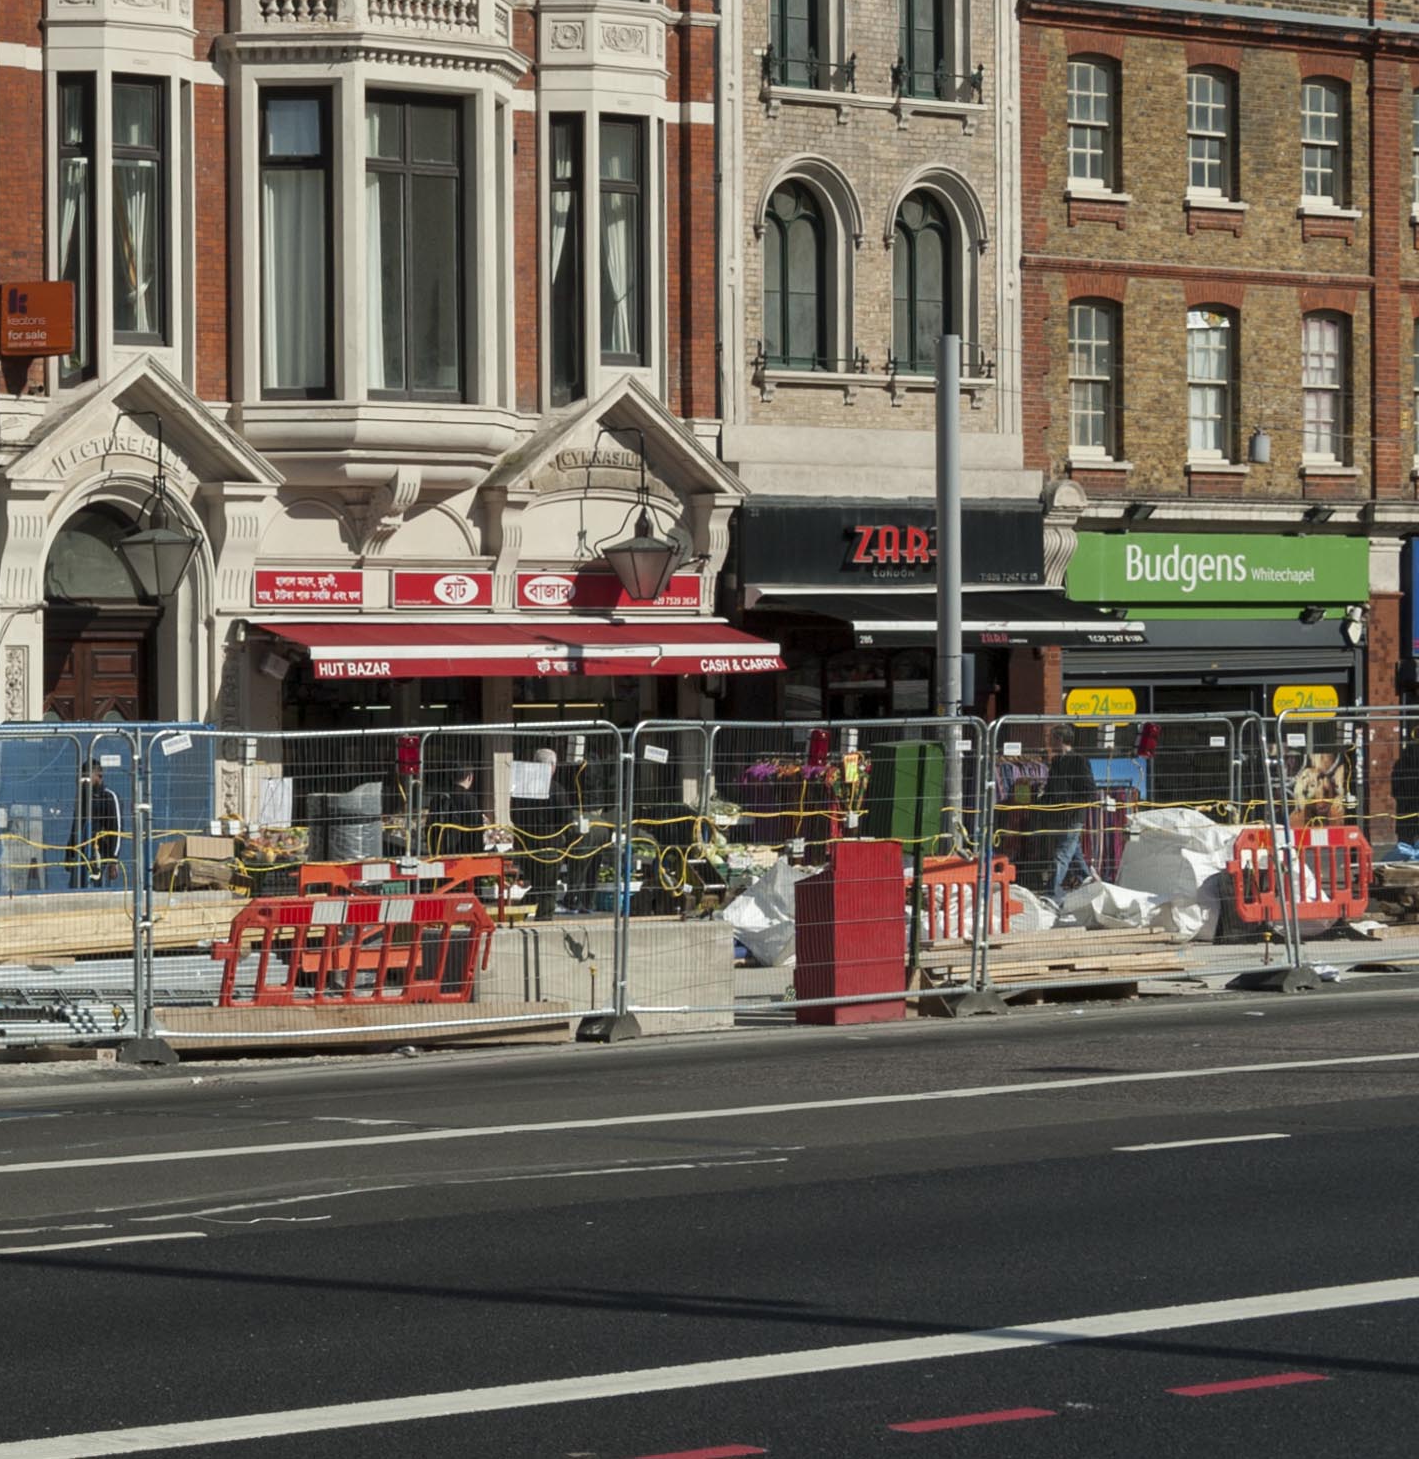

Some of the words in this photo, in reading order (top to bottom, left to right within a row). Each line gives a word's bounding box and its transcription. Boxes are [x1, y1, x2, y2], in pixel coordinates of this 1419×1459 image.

[8, 330, 23, 340] for
[25, 330, 47, 340] sale
[56, 435, 139, 472] LECTURE
[852, 525, 937, 564] ZAR
[1125, 544, 1247, 592] Budgens
[1250, 567, 1316, 585] Whitechapel
[443, 576, 468, 601] হাট
[318, 662, 345, 676] HUT
[347, 662, 391, 676] BAZAR
[700, 659, 731, 672] CASH
[732, 659, 741, 672] &
[741, 658, 779, 671] CARRY
[1091, 694, 1110, 716] 24
[1296, 691, 1314, 710] 24
